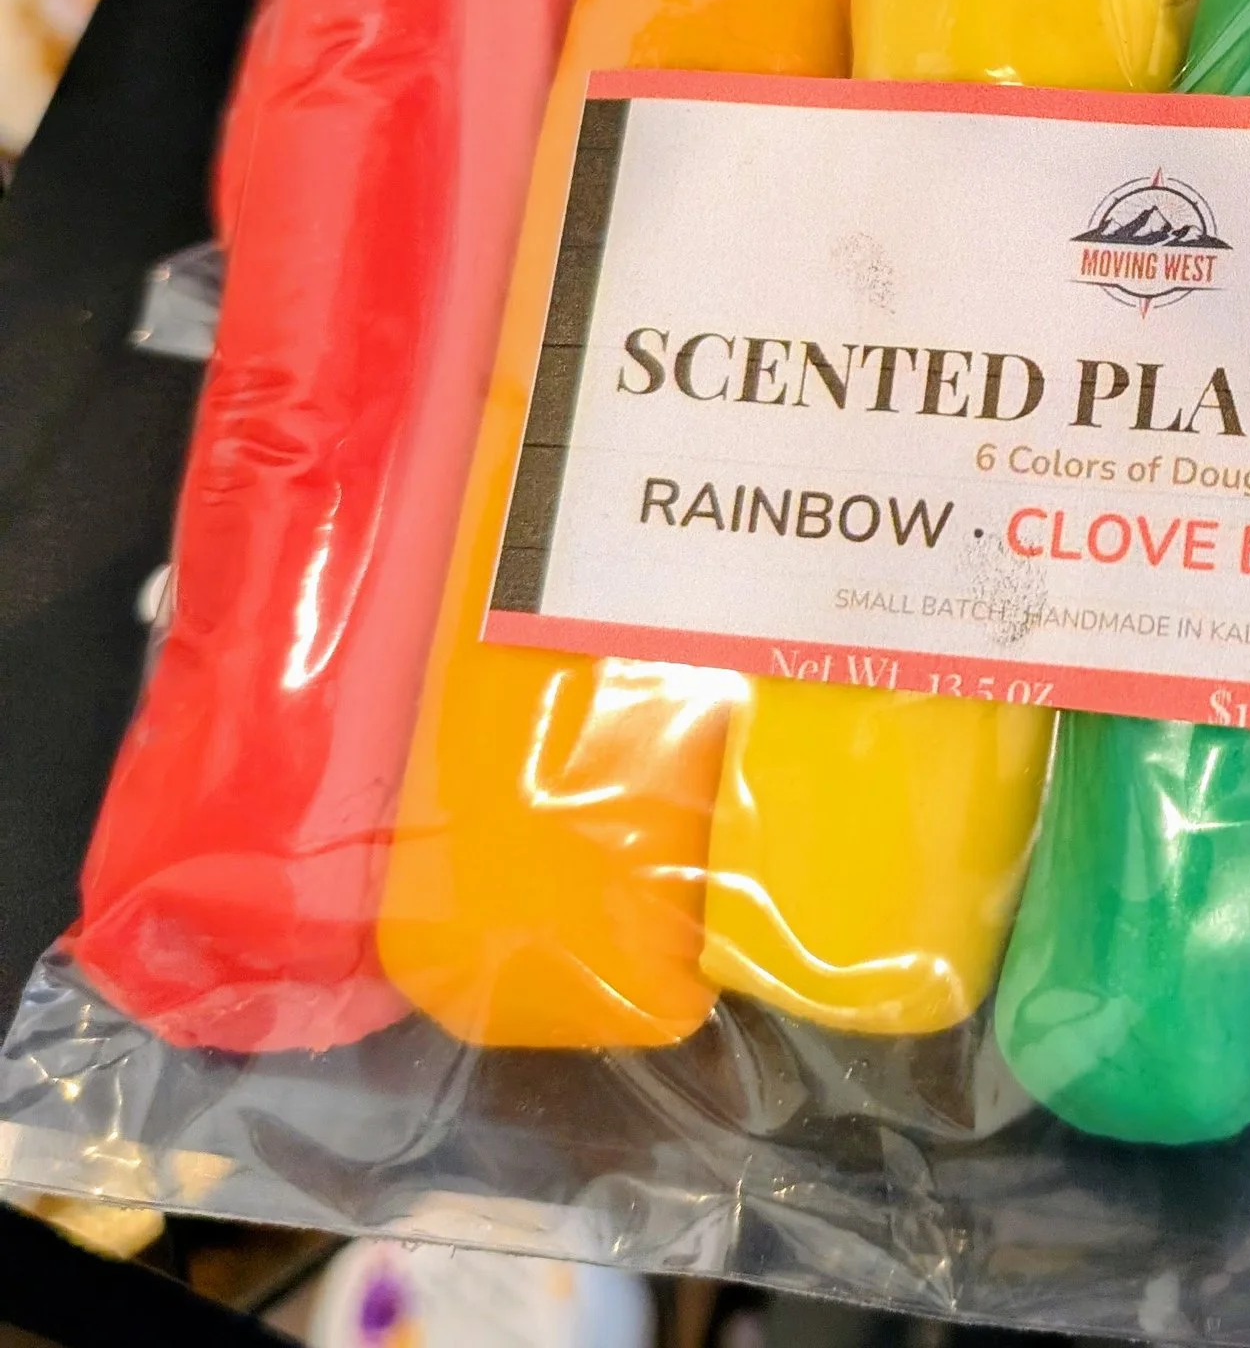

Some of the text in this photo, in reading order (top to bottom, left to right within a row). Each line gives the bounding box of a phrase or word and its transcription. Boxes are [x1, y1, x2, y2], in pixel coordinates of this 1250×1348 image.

[1080, 249, 1218, 283] MOVING WEST
[616, 326, 1045, 422] SCENTED
[975, 443, 998, 471] 6
[1008, 445, 1116, 481] Colors
[1127, 455, 1163, 483] of
[639, 477, 955, 549] RAINBOW
[1006, 507, 1220, 570] CLOVE
[834, 588, 914, 615] SMALL
[1023, 602, 1170, 638] HANDMADE
[1177, 617, 1203, 639] IN
[771, 647, 834, 682] Net
